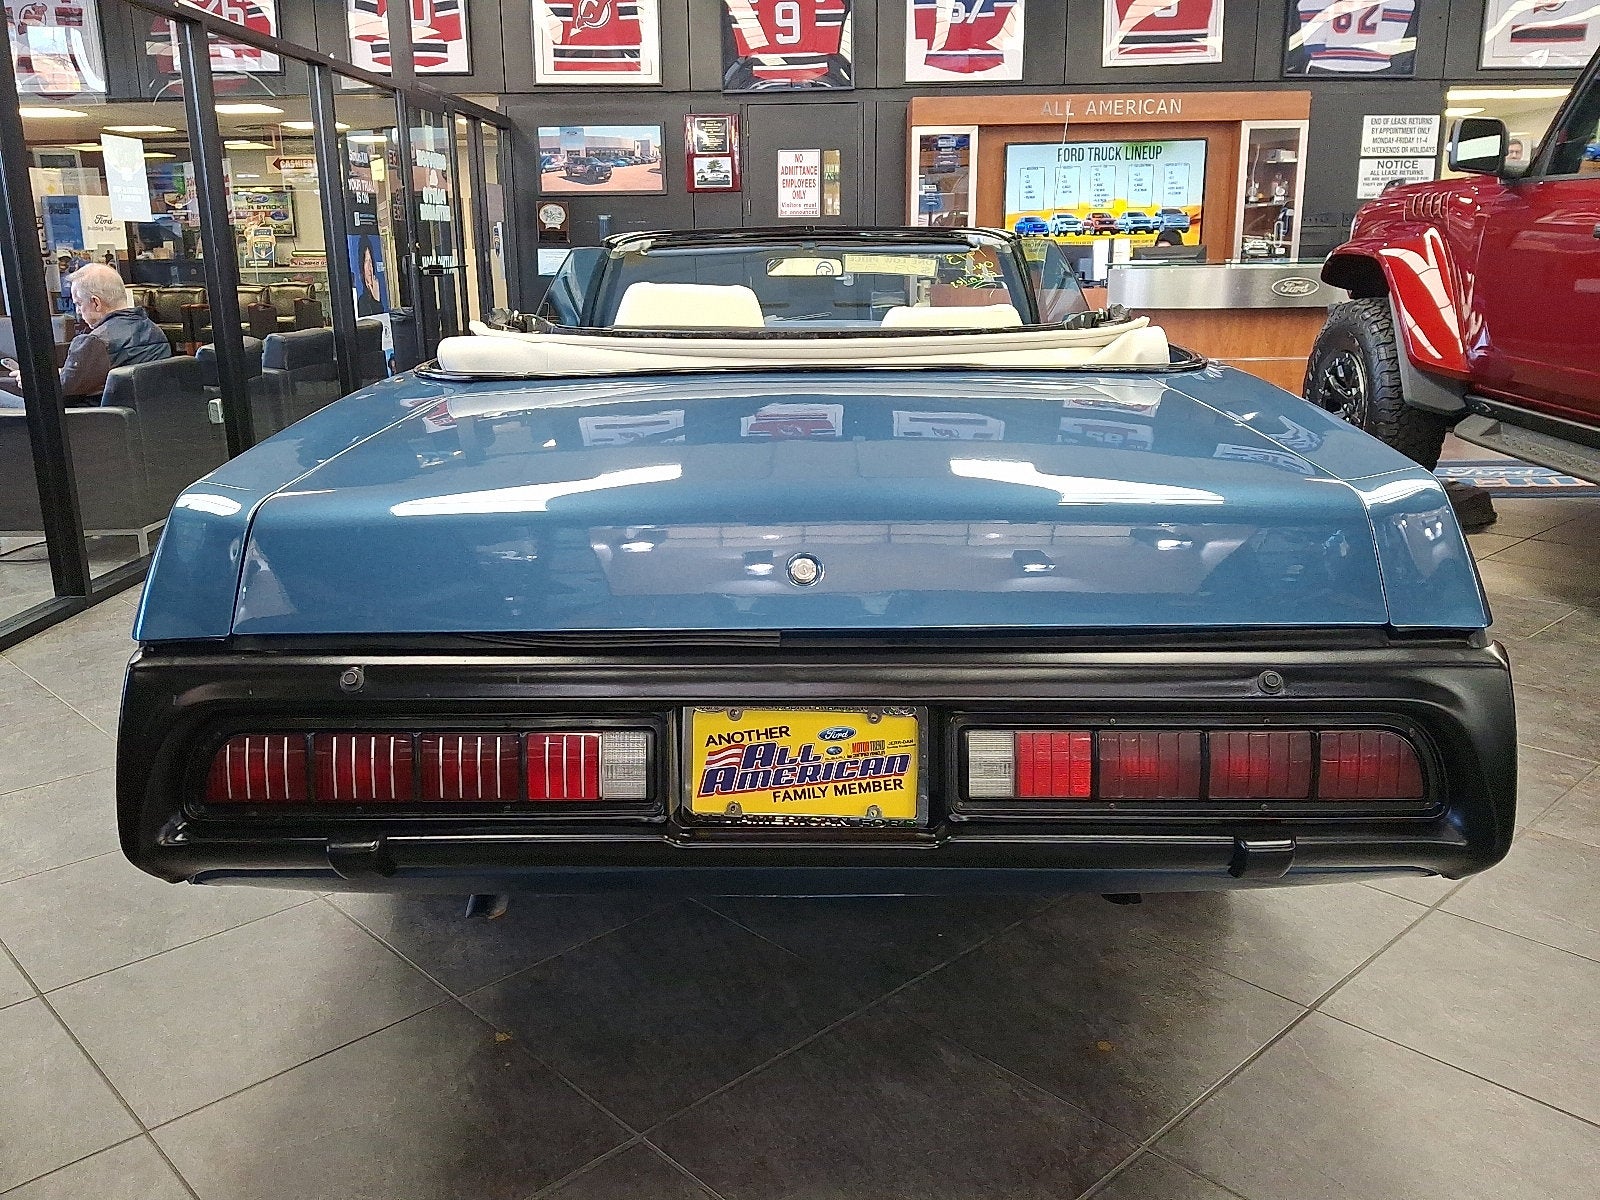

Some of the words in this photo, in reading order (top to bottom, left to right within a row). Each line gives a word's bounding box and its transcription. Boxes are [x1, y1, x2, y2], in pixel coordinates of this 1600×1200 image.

[774, 0, 801, 44] 9
[1041, 101, 1075, 117] ALL
[1085, 98, 1182, 116] AMERICAN
[1370, 117, 1382, 125] END
[1383, 117, 1390, 125] OF
[1390, 117, 1408, 125] LEASE
[1409, 117, 1433, 125] RETURNS
[1378, 127, 1416, 135] APPOINTMENT
[794, 153, 804, 163] NO
[1057, 147, 1085, 162] FORD
[1088, 146, 1122, 161] TRUCK
[1125, 145, 1163, 161] LINEUP
[280, 159, 313, 169] CASHIER
[1376, 160, 1419, 169] NOTICE
[780, 165, 818, 175] ADMITTANCE
[782, 178, 817, 189] EMPLOYEES
[791, 189, 807, 199] ONLY
[94, 214, 113, 225] Ford
[1280, 280, 1310, 293] Ford
[704, 725, 791, 748] ANOTHER
[824, 728, 849, 740] Ford
[741, 743, 821, 770] ALL
[698, 754, 912, 796] AMERICAN
[772, 786, 829, 803] FAMILY
[833, 778, 904, 797] MEMBER
